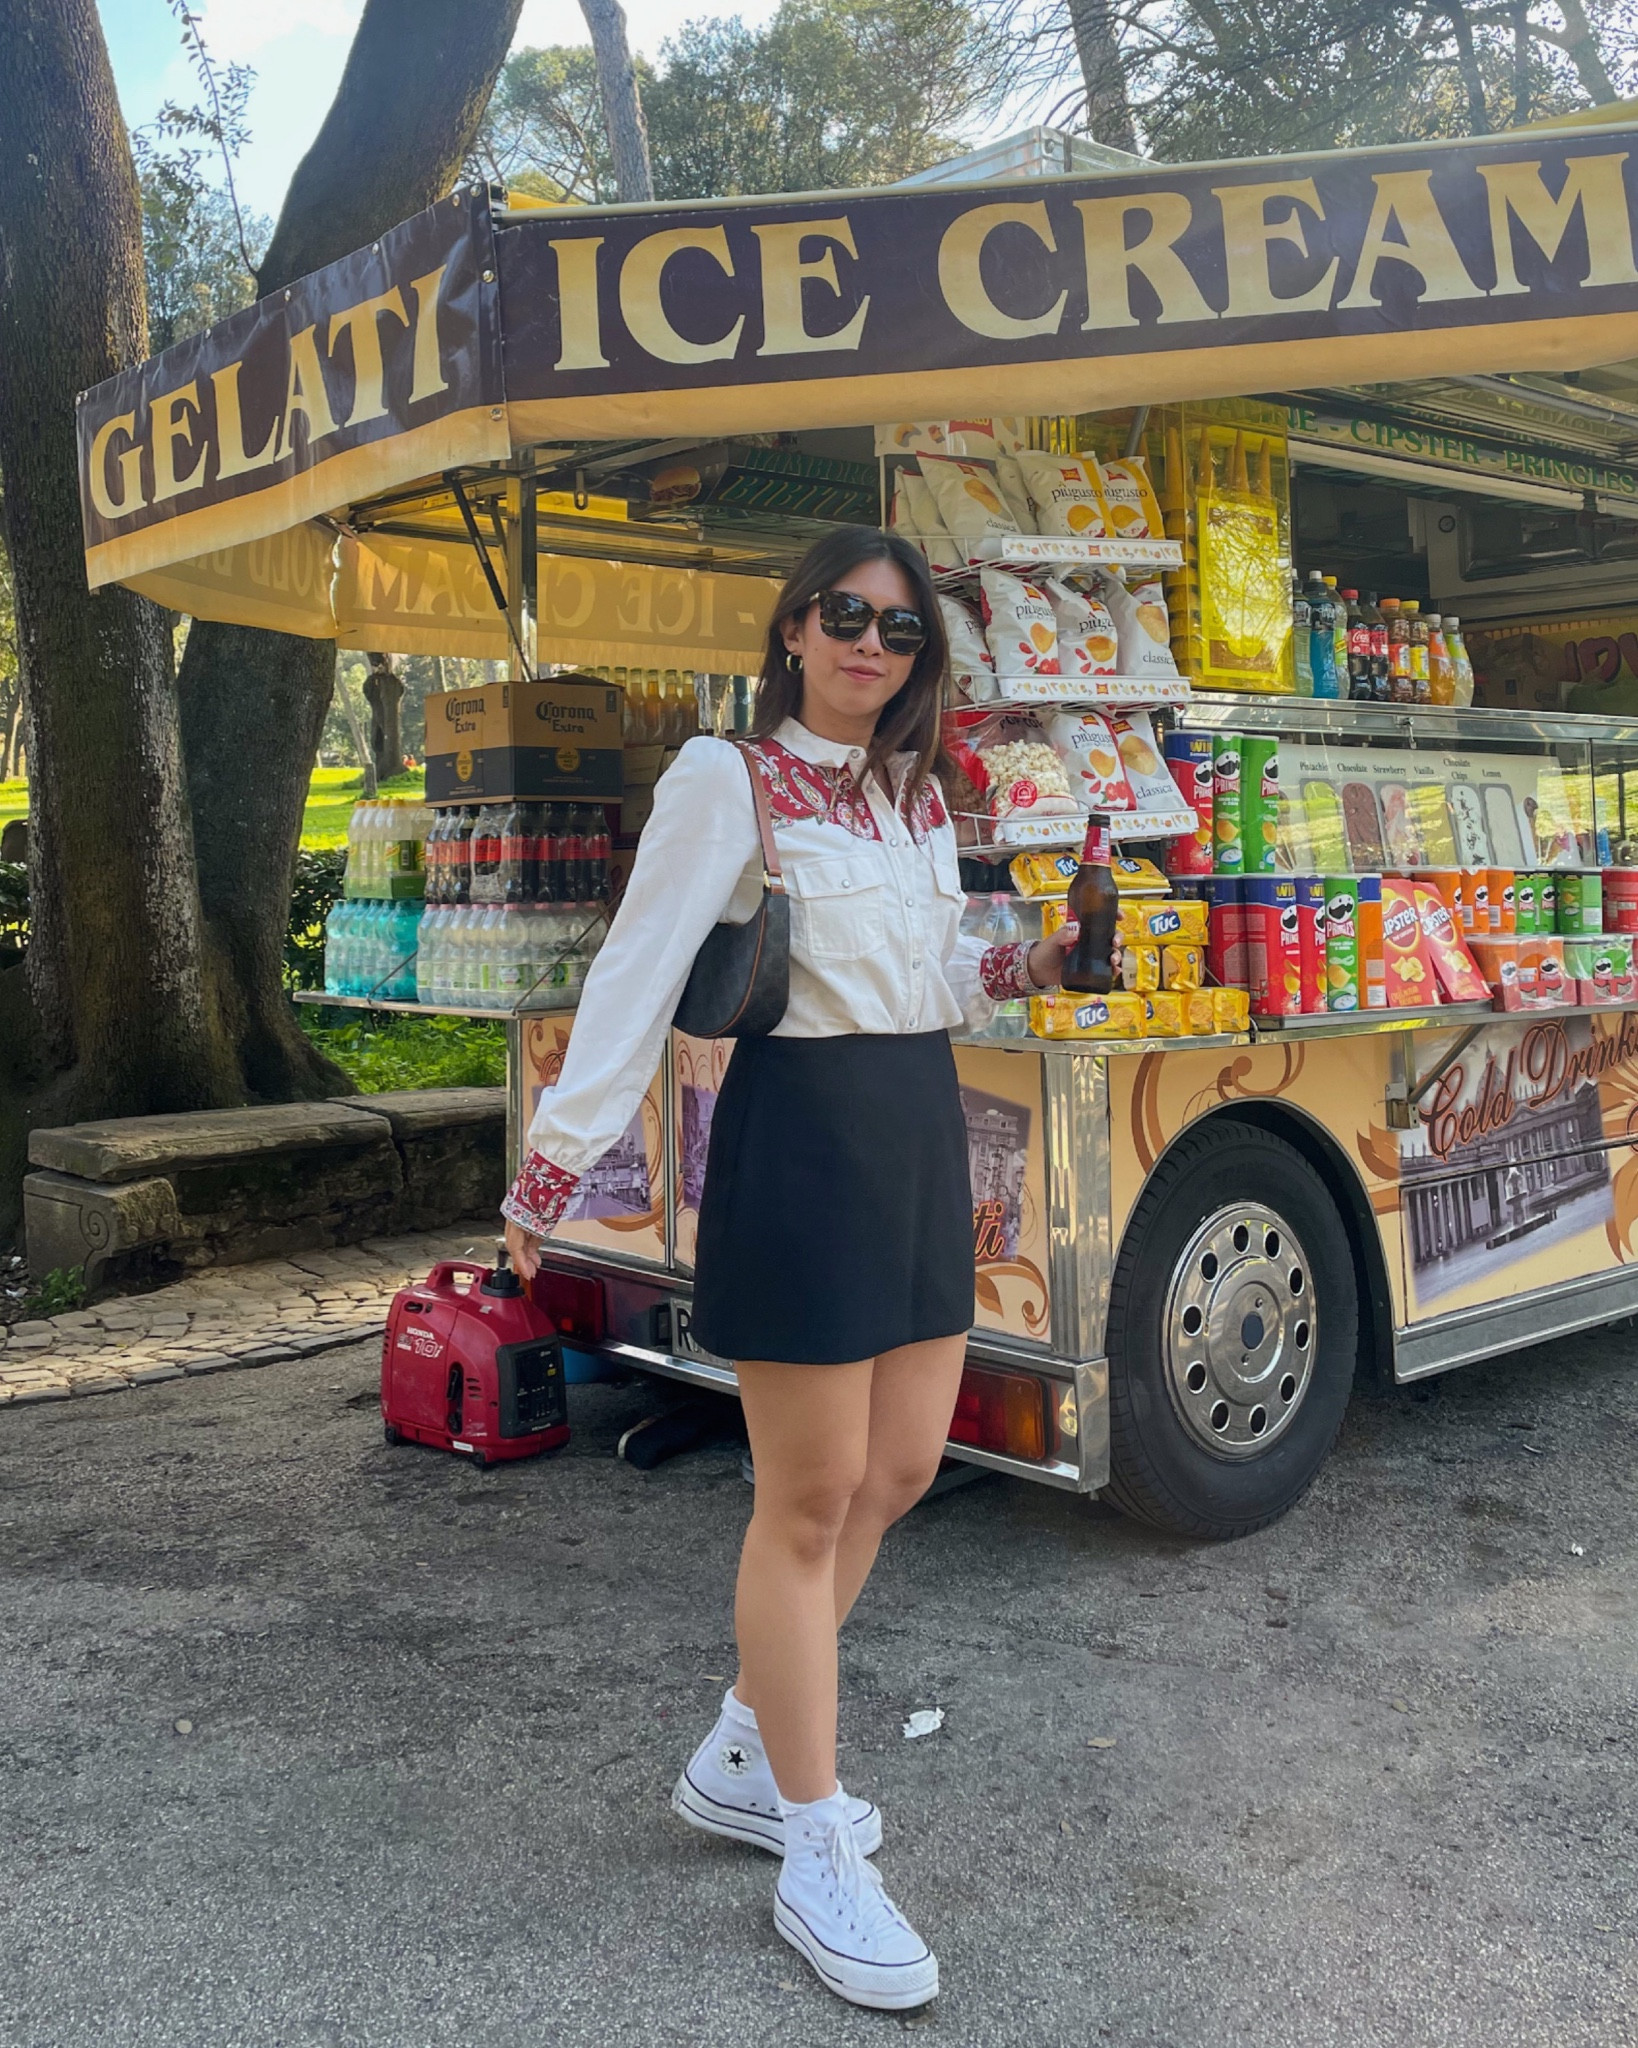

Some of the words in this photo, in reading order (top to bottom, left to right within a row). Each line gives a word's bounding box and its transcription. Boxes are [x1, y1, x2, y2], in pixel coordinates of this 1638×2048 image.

[547, 216, 871, 372] ICE
[938, 152, 1638, 339] CREAM
[90, 265, 449, 519] GELATI
[1350, 418, 1480, 465] CIPSTER
[1504, 449, 1636, 494] PRINGLES
[446, 697, 486, 721] Corona
[536, 700, 598, 722] Corona
[454, 721, 476, 733] Extra
[552, 719, 584, 733] Extra
[1135, 783, 1173, 800] classica
[1057, 858, 1079, 876] TUC
[1120, 859, 1141, 873] TUC
[1150, 915, 1180, 936] TUC
[1077, 1005, 1107, 1028] TUC
[1419, 1046, 1517, 1163] Cold
[407, 1326, 435, 1340] HONDA
